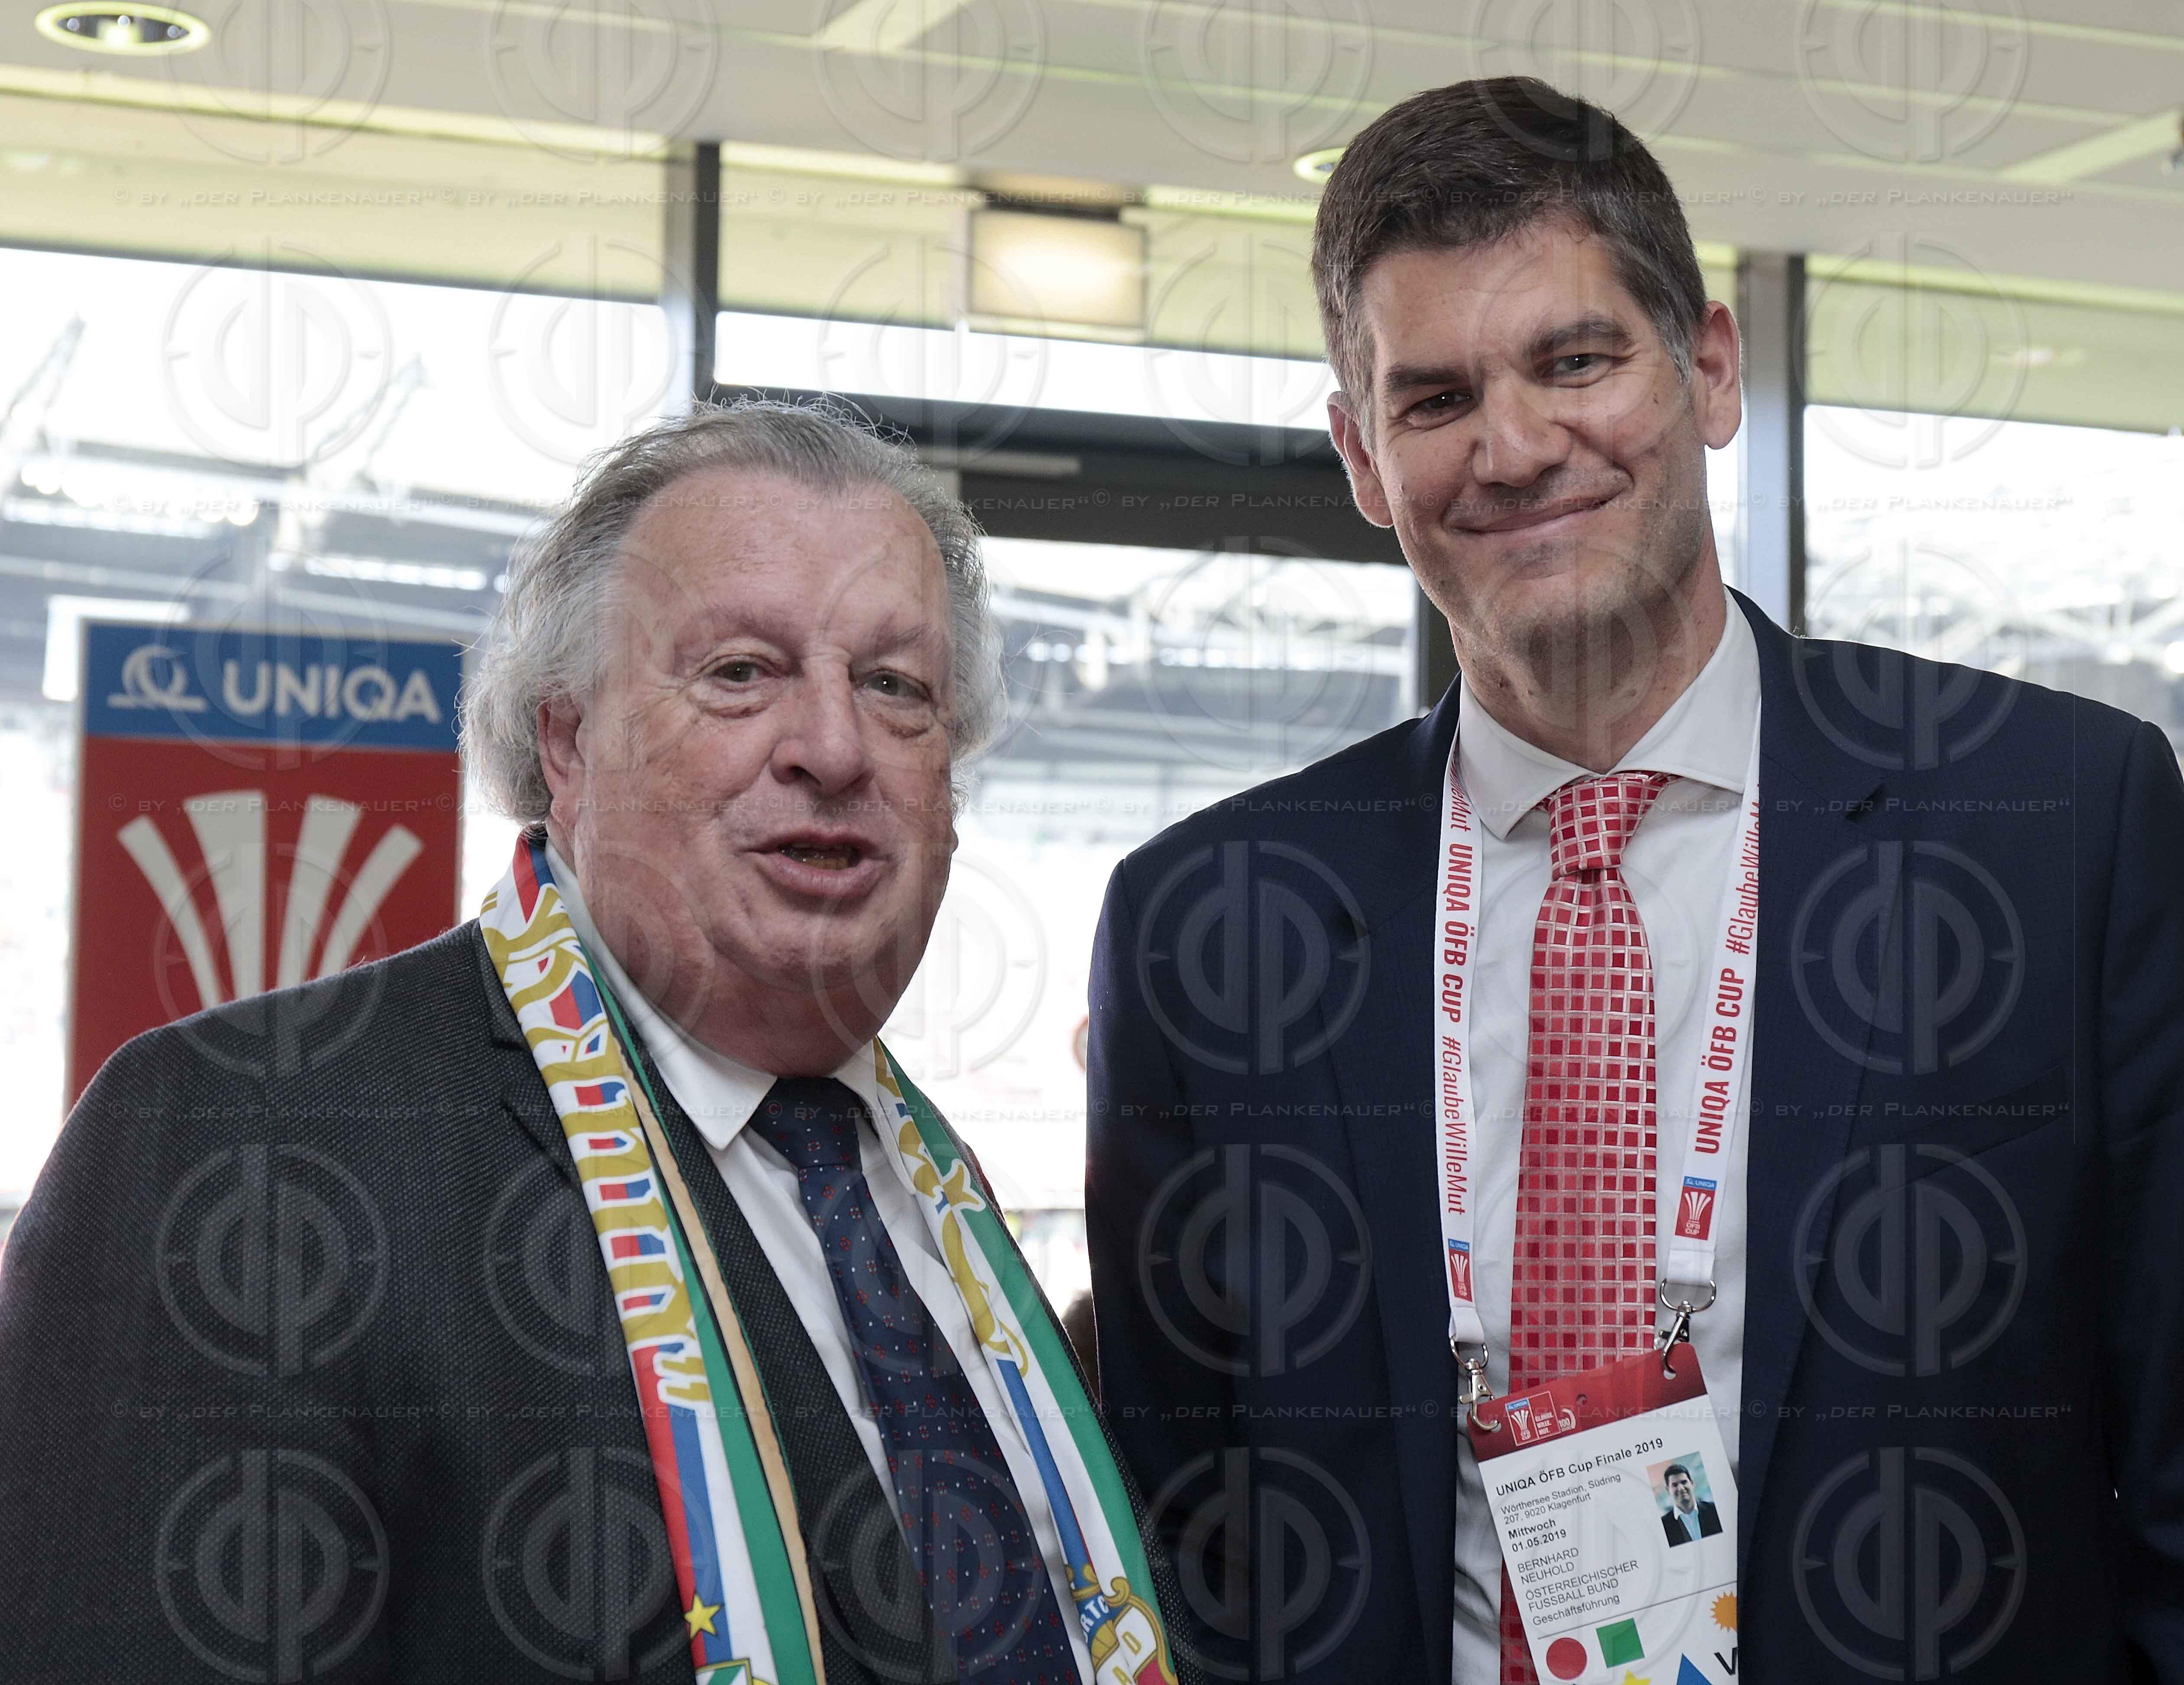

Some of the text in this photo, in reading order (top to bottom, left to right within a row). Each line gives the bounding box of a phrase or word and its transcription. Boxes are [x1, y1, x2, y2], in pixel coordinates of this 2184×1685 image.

[224, 659, 440, 722] UNIQA
[1444, 843, 1472, 911] UNIQA
[1444, 921, 1475, 966] ÖFB
[1442, 974, 1463, 1023] CUP
[1716, 968, 1744, 1017] CUP
[1701, 1025, 1736, 1071] ÖFB
[1442, 1036, 1468, 1215] #GlaubeWilleMut
[1695, 1081, 1730, 1155] UNIQA
[1496, 1438, 1664, 1496] UNIQA ÖFB Cup Finale 2019
[1501, 1474, 1621, 1515] Wörthersee Stadion, Südring
[1504, 1493, 1591, 1525] 207, 9020 Klagenfurt
[1508, 1518, 1557, 1540] Mittwoch
[1512, 1529, 1566, 1552] 01.05.2019
[1517, 1547, 1579, 1573] BERNHARD
[1520, 1561, 1575, 1585] NEUHOLD
[1525, 1560, 1639, 1600] ÖSTERREICHISCHER
[1528, 1578, 1619, 1612] FUSSBALL BUND
[1533, 1594, 1621, 1626] Geschäftsführung
